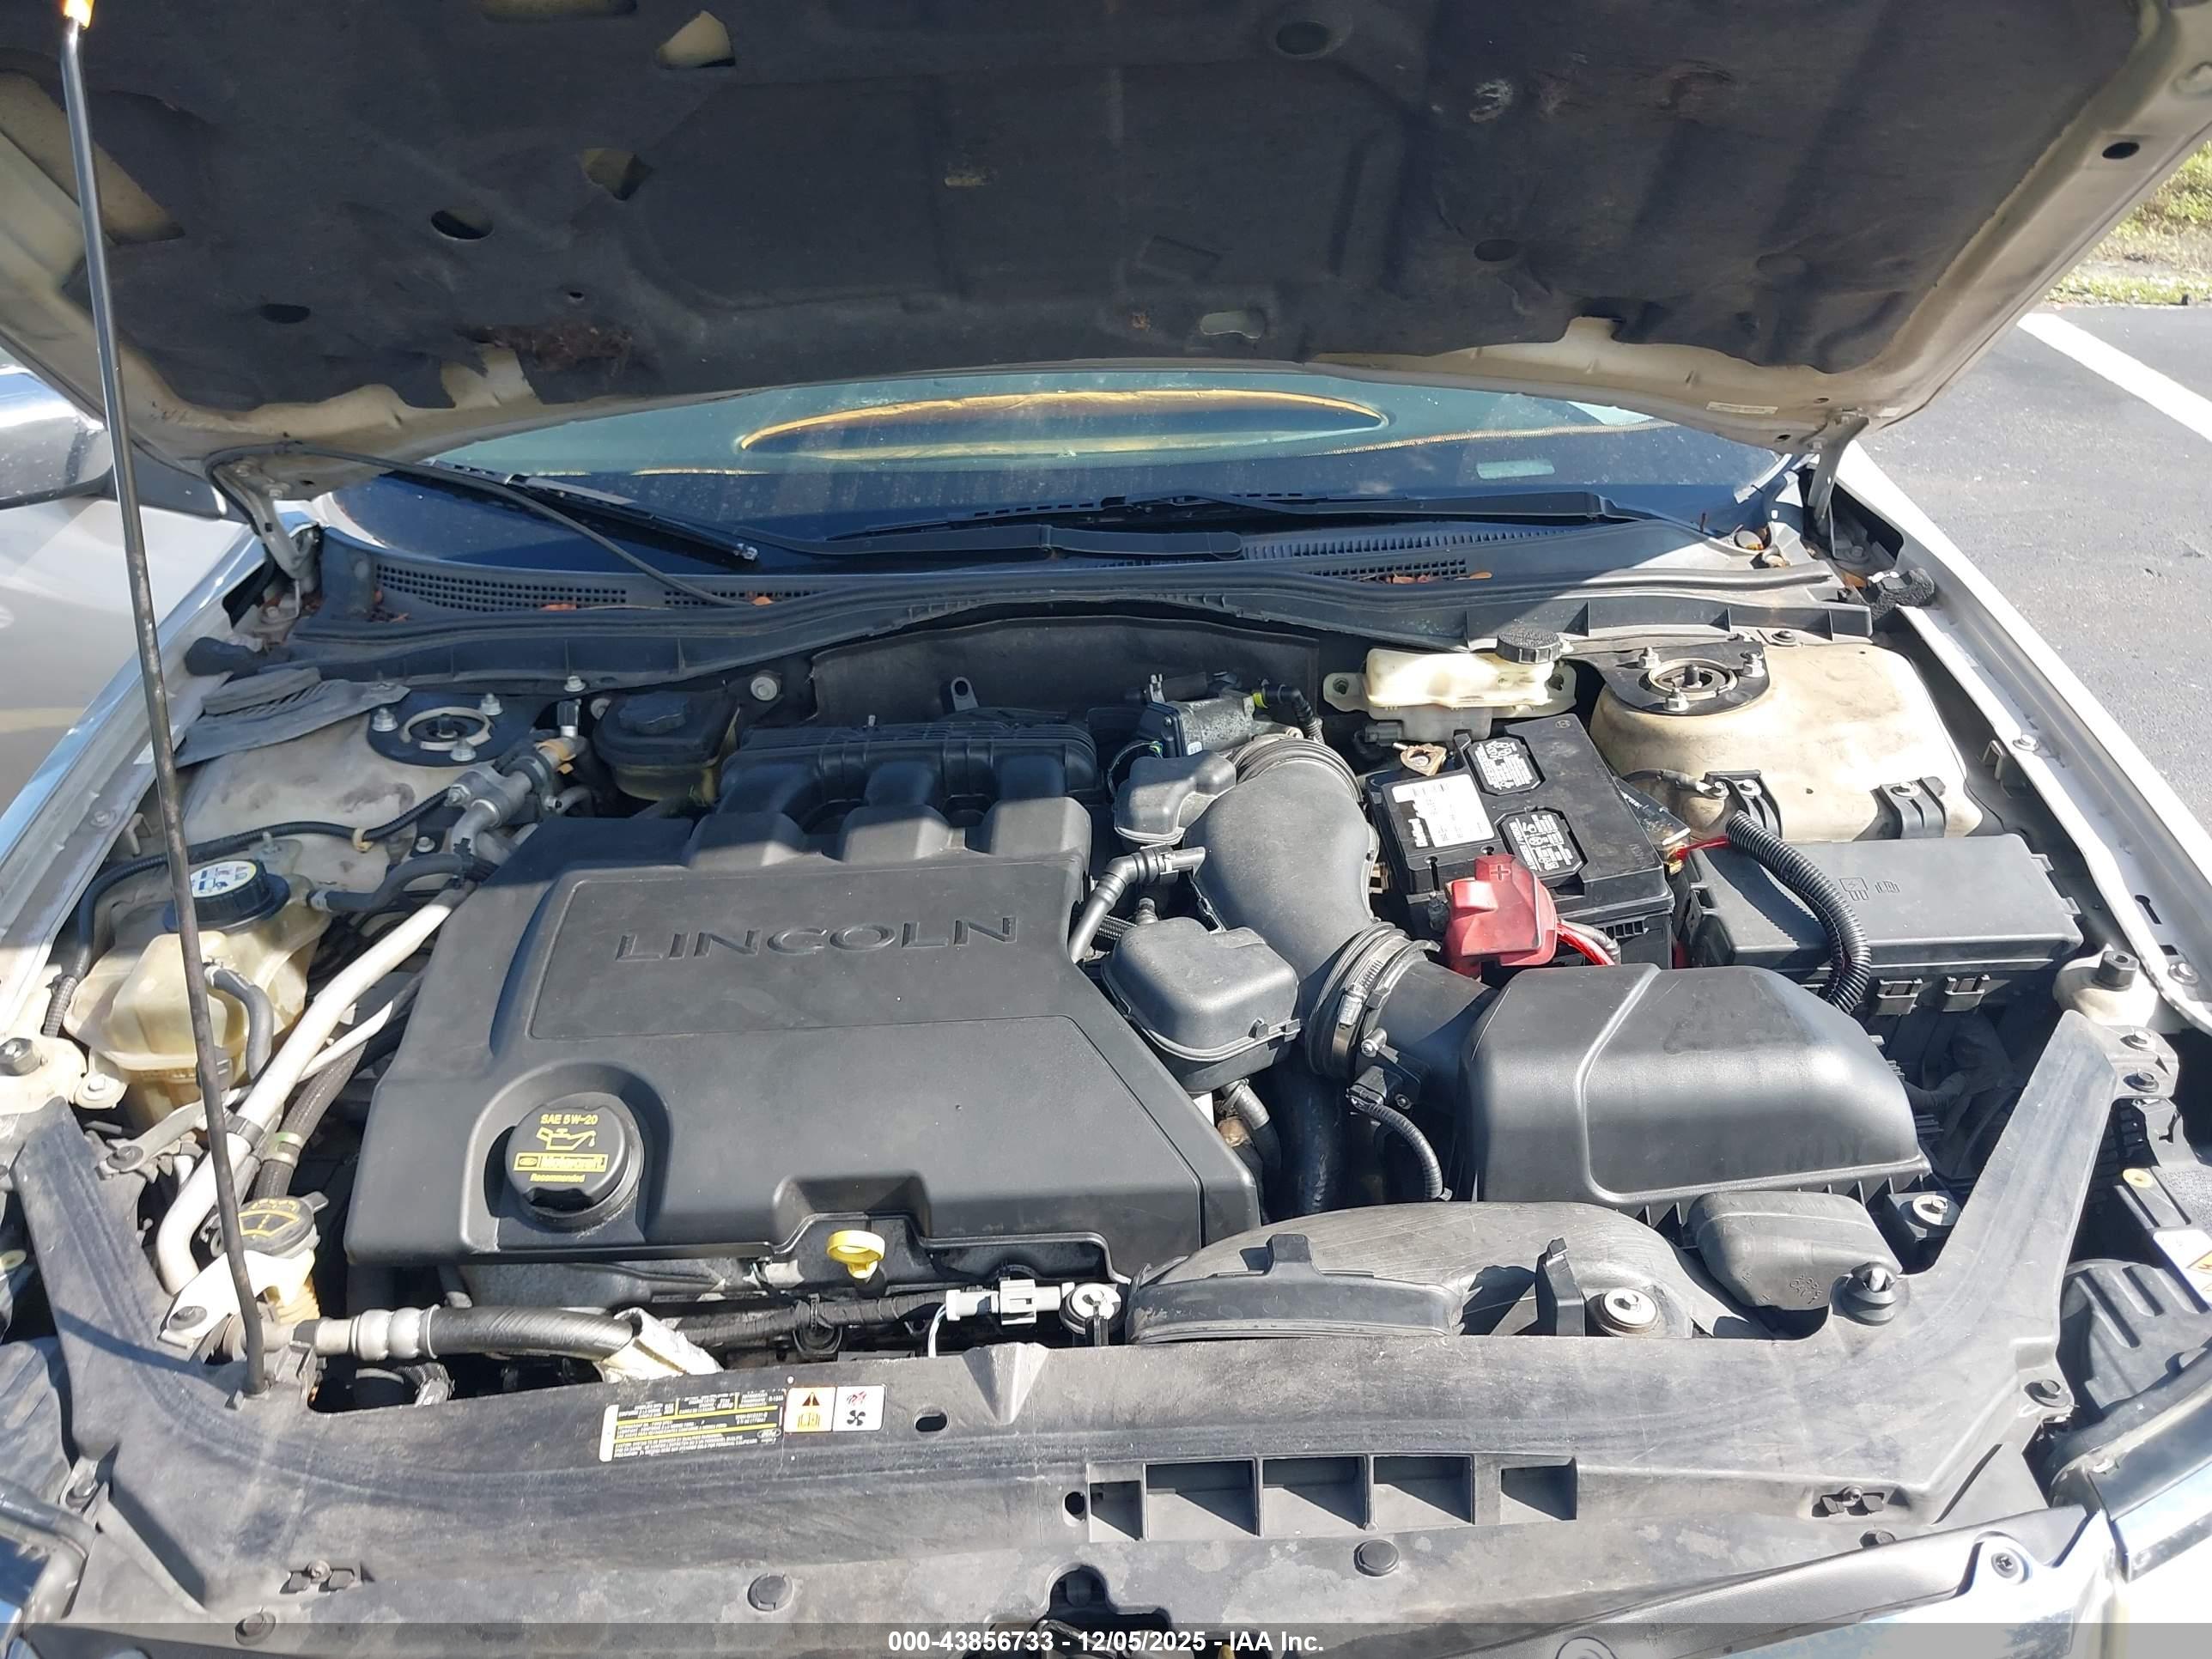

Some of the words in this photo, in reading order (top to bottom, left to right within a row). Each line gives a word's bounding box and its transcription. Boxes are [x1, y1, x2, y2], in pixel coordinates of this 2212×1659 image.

[616, 915, 1017, 962] LINCOLN
[540, 1114, 562, 1125] SAE
[530, 1173, 586, 1182] Recommended
